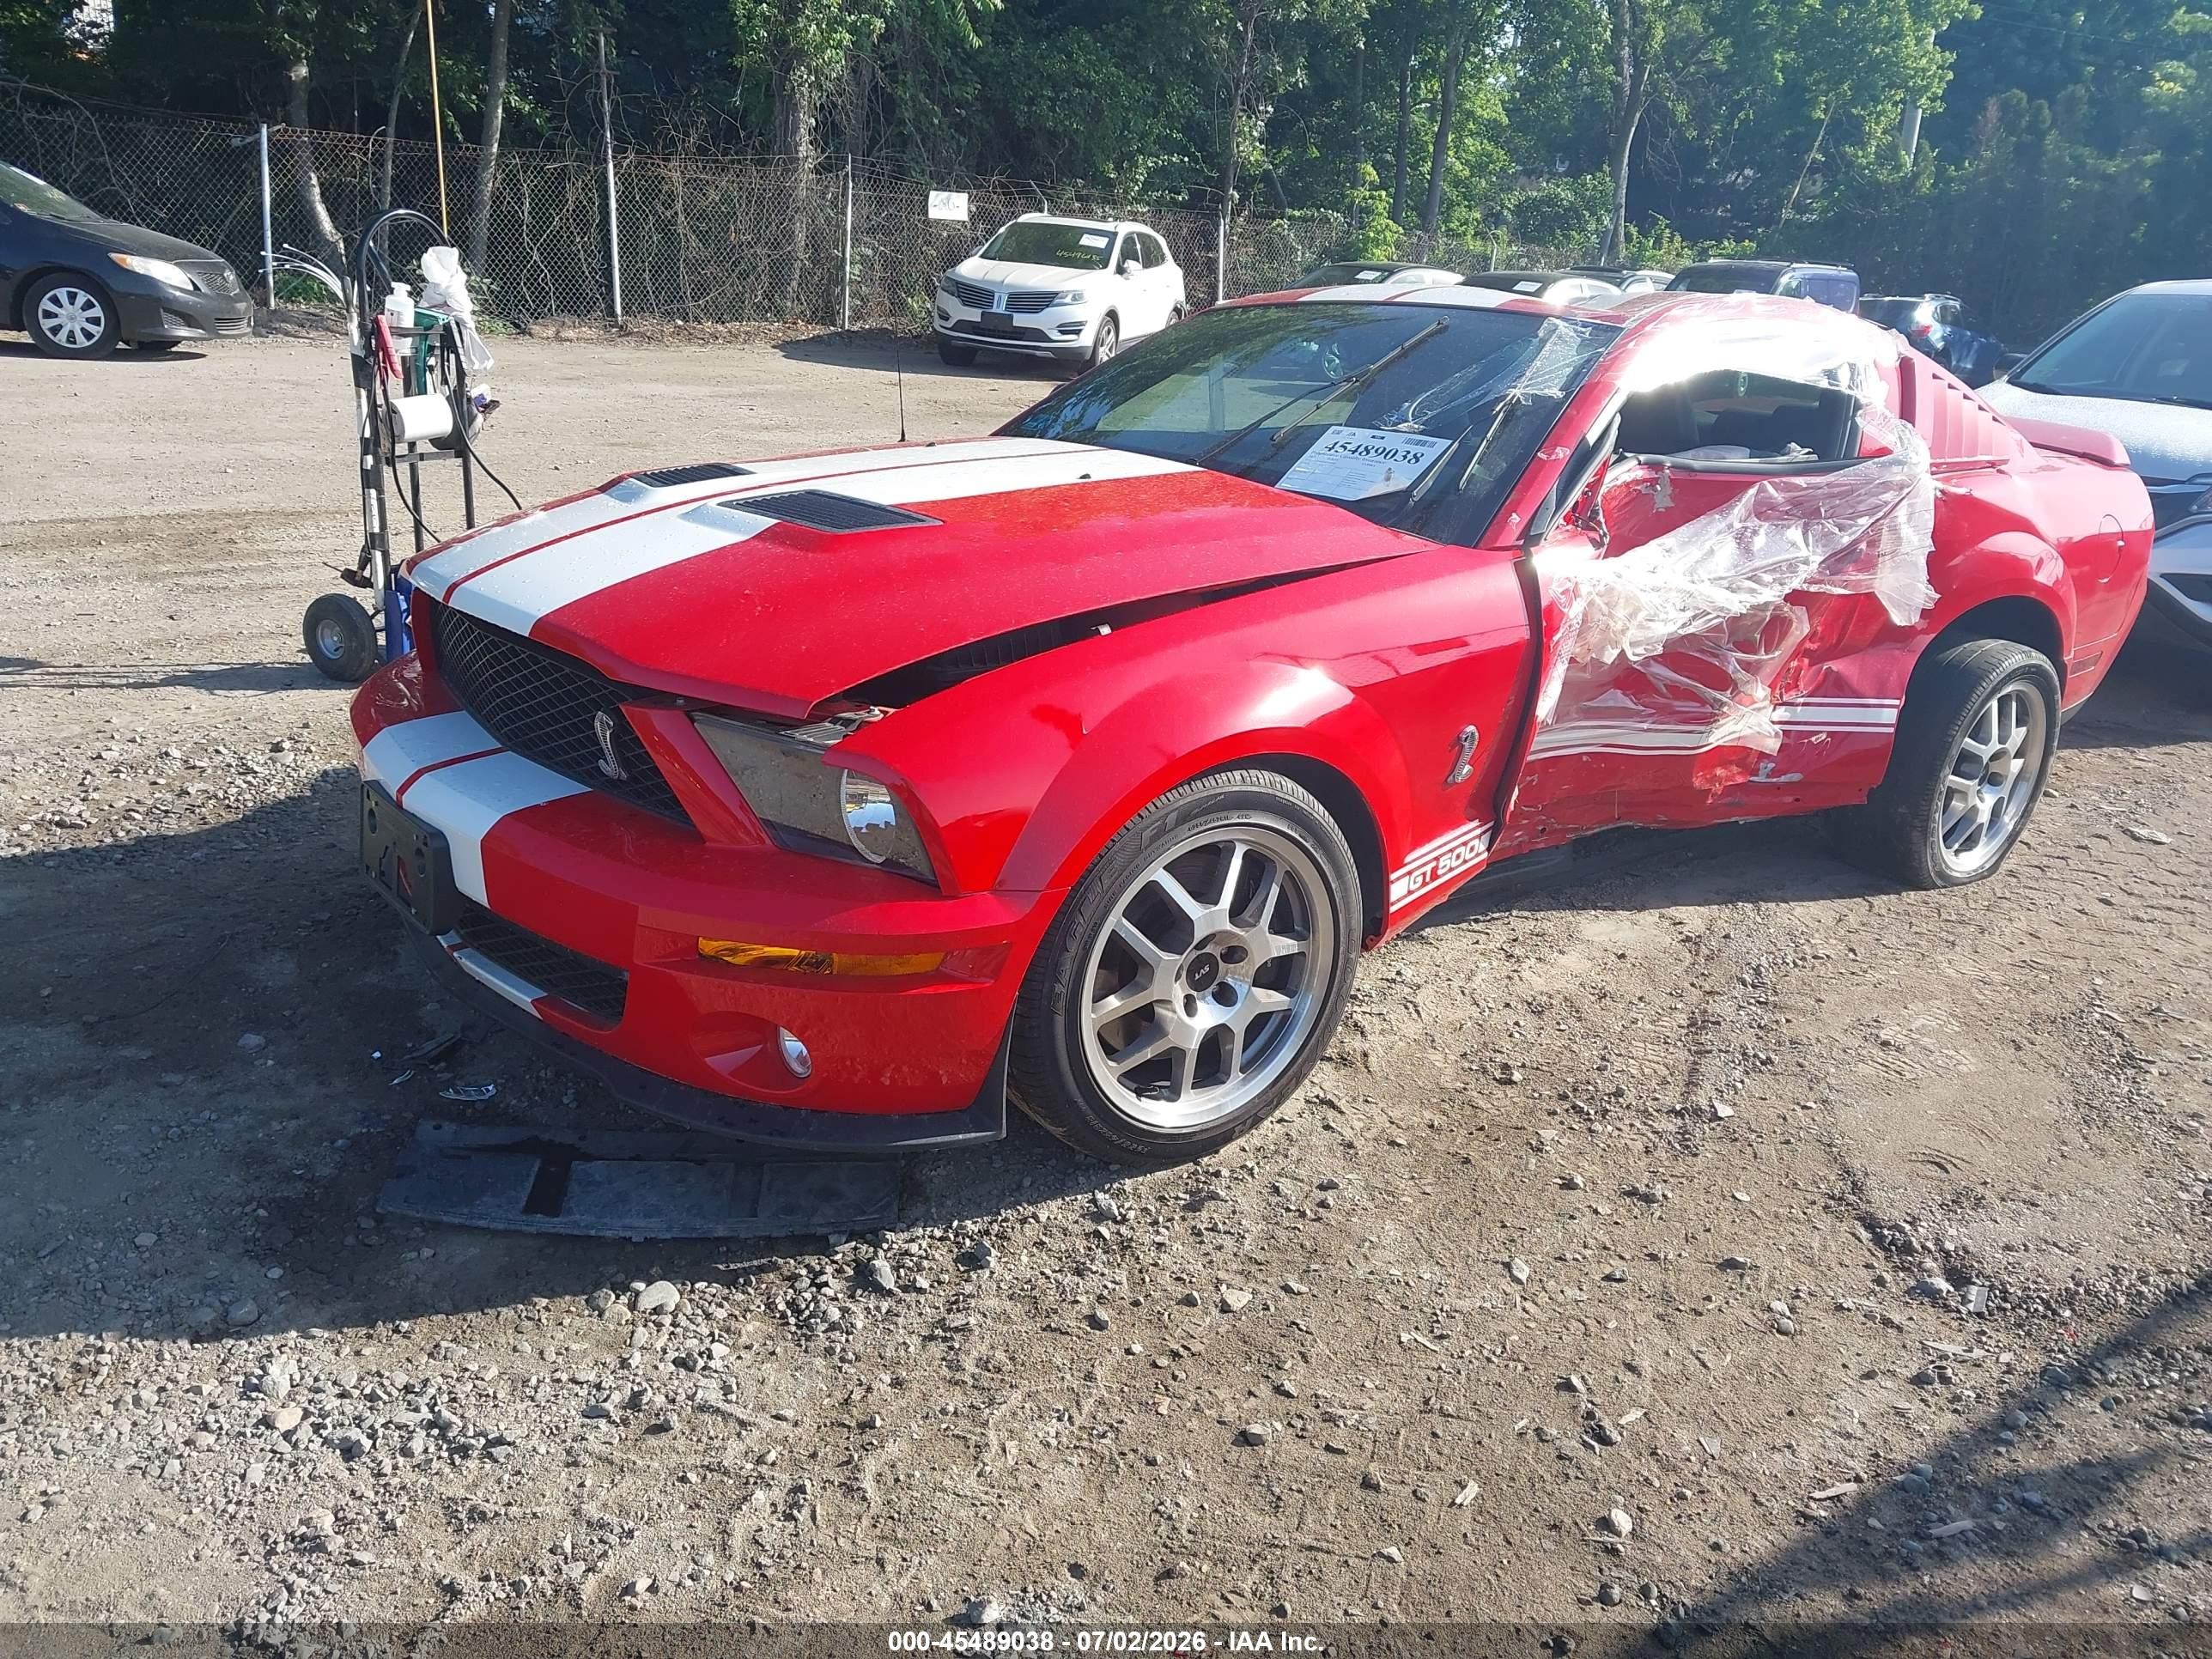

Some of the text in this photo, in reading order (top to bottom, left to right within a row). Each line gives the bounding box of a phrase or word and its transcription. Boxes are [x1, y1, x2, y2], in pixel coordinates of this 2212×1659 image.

[1324, 440, 1425, 465] 45489038
[1408, 836, 1480, 891] GT 500
